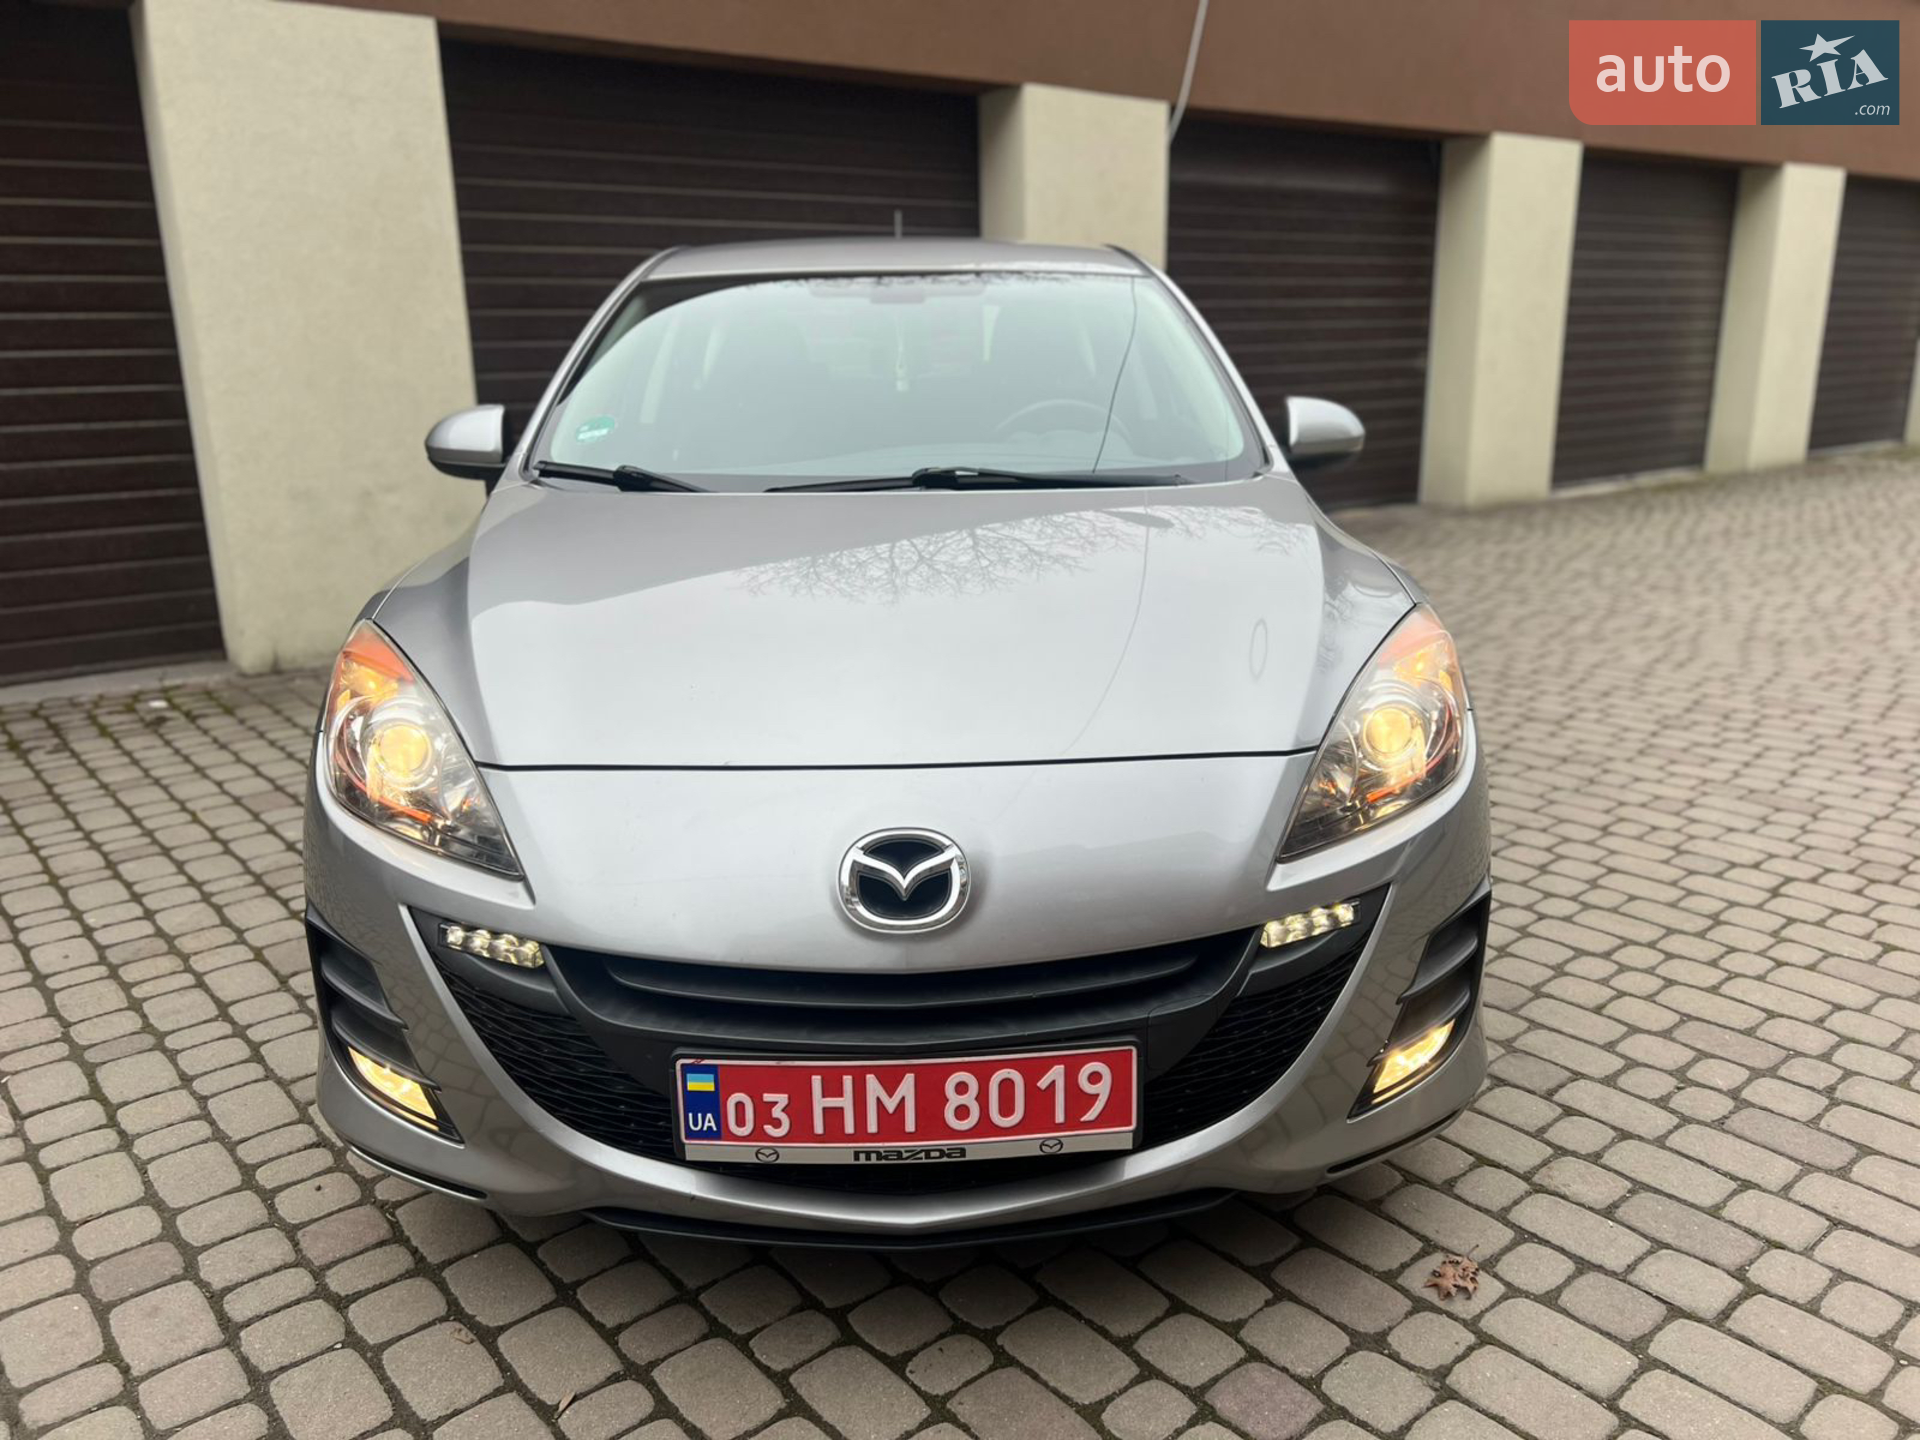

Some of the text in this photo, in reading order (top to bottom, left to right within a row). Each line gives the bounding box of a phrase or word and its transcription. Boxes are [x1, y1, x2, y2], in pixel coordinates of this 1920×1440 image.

[688, 1112, 718, 1132] UA
[726, 1061, 1113, 1138] 03 HM 8019
